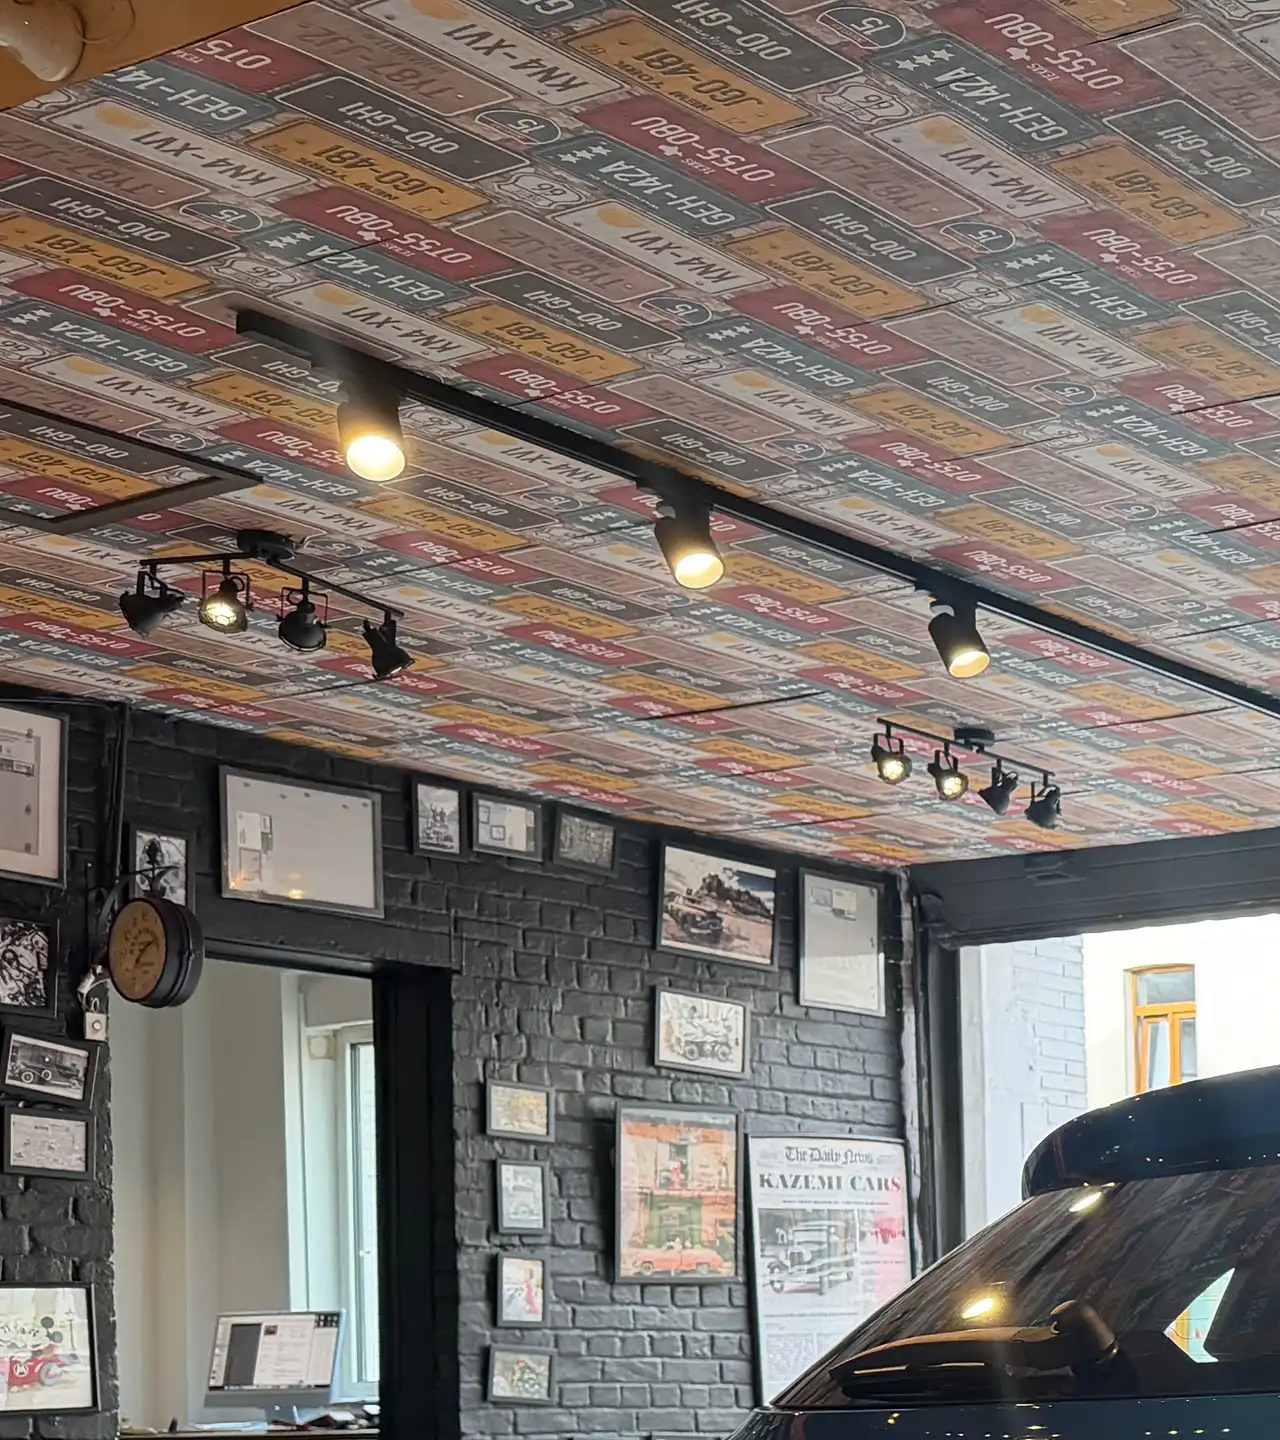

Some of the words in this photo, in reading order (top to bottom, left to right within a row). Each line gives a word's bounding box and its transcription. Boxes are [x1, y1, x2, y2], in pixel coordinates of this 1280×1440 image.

[847, 15, 896, 35] 15
[436, 22, 595, 93] KN4-XV1
[1021, 61, 1063, 81] TEXAS
[504, 116, 551, 133] 15
[924, 65, 1076, 140] GEH-142A
[134, 131, 272, 190] KN4-XV1
[676, 157, 717, 174] TEXAS
[934, 147, 1063, 206] KN4-XV1
[589, 159, 743, 224] GEH-142A
[206, 207, 251, 222] 15
[966, 228, 1007, 242] 15
[297, 244, 452, 301] GEH-142A
[615, 231, 746, 282] KN4-XV1
[1029, 266, 1155, 320] GEH-142A
[40, 321, 194, 371] GEH-142A
[337, 307, 467, 352] KN4-XV1
[1030, 325, 1139, 369] KN4-XV1
[732, 338, 861, 386] GEH-142A
[90, 376, 220, 417] KN4-XV1
[748, 389, 859, 428] KN4-XV1
[1105, 414, 1213, 456] GEH-142A
[784, 1146, 808, 1162] The
[809, 1147, 842, 1164] Daily
[841, 1149, 874, 1165] News
[758, 1173, 842, 1190] KAZEMI
[850, 1175, 901, 1193] CARS
